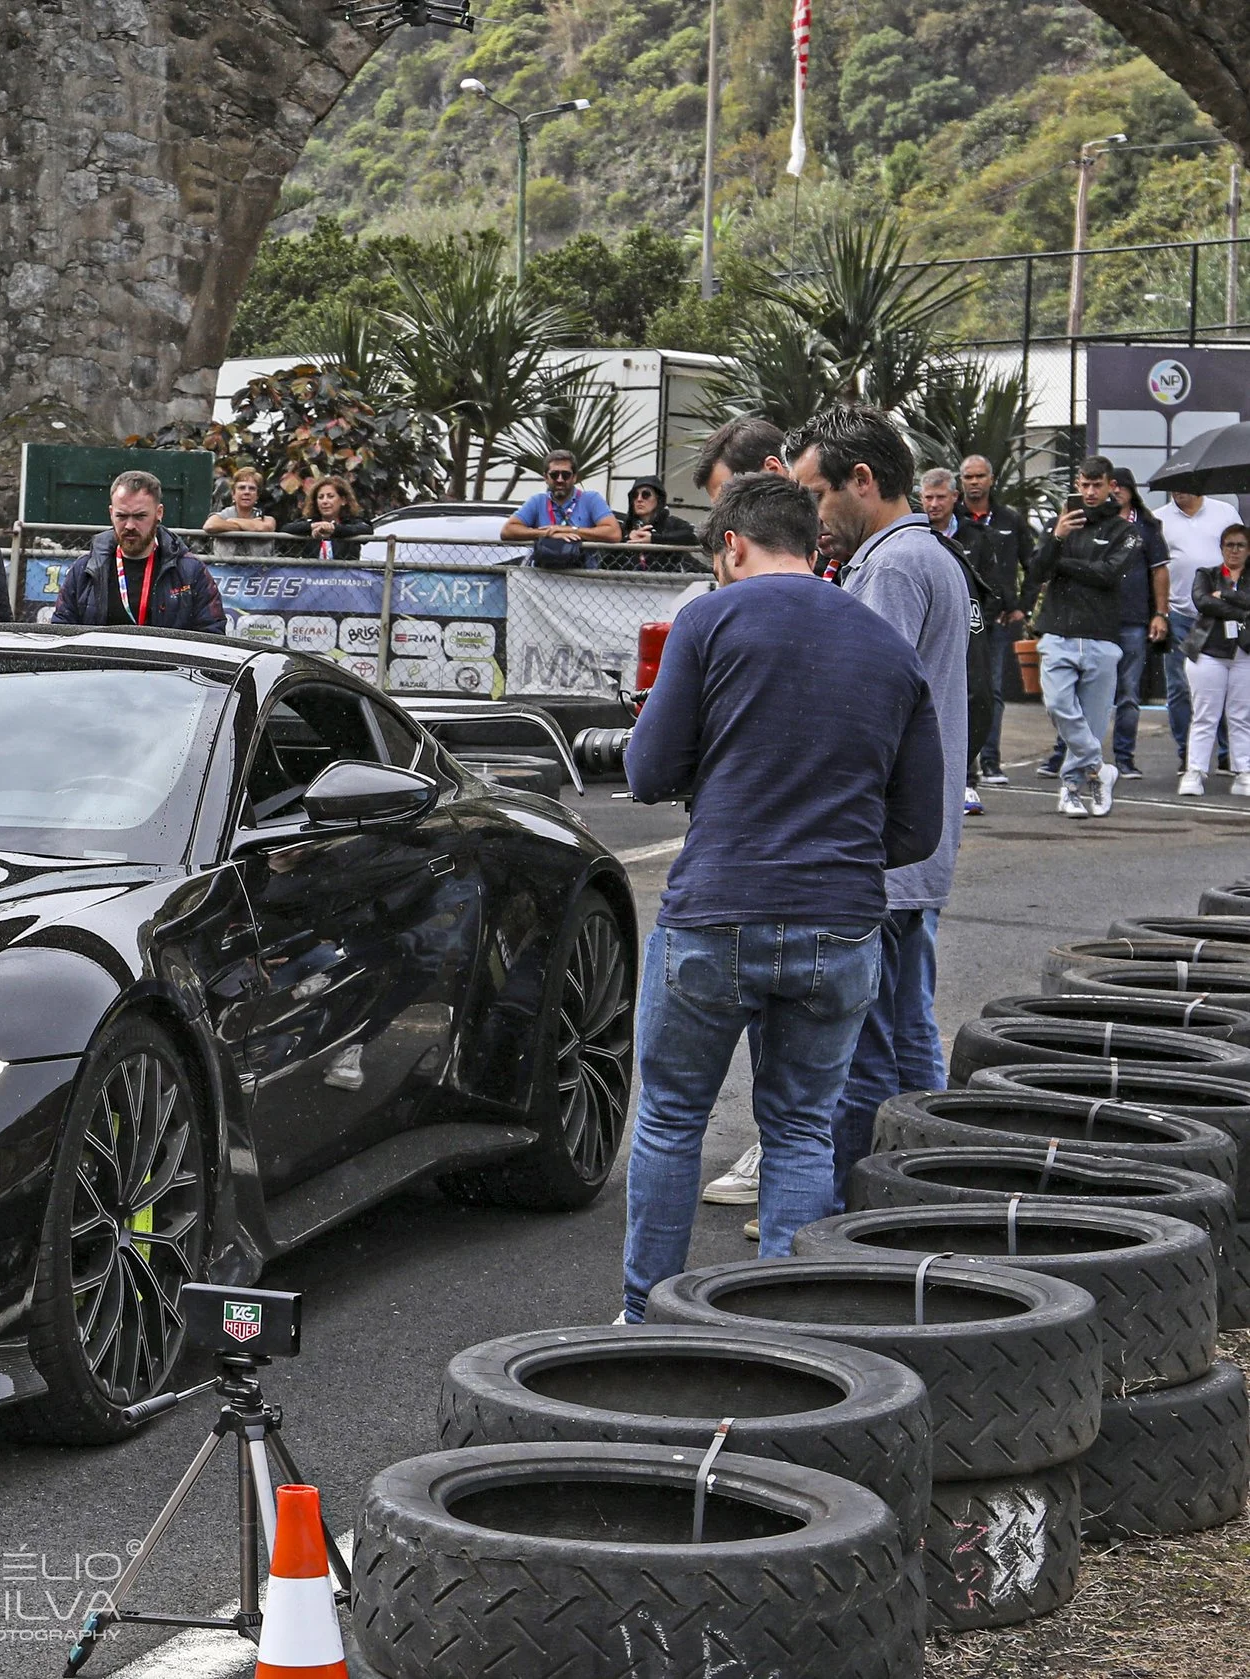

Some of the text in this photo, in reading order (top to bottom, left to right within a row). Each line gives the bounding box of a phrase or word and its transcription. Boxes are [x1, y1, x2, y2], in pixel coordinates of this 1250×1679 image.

[1160, 374, 1181, 387] NP
[400, 578, 490, 604] K-ART
[230, 1305, 255, 1320] TAG
[226, 1321, 258, 1339] HEUER
